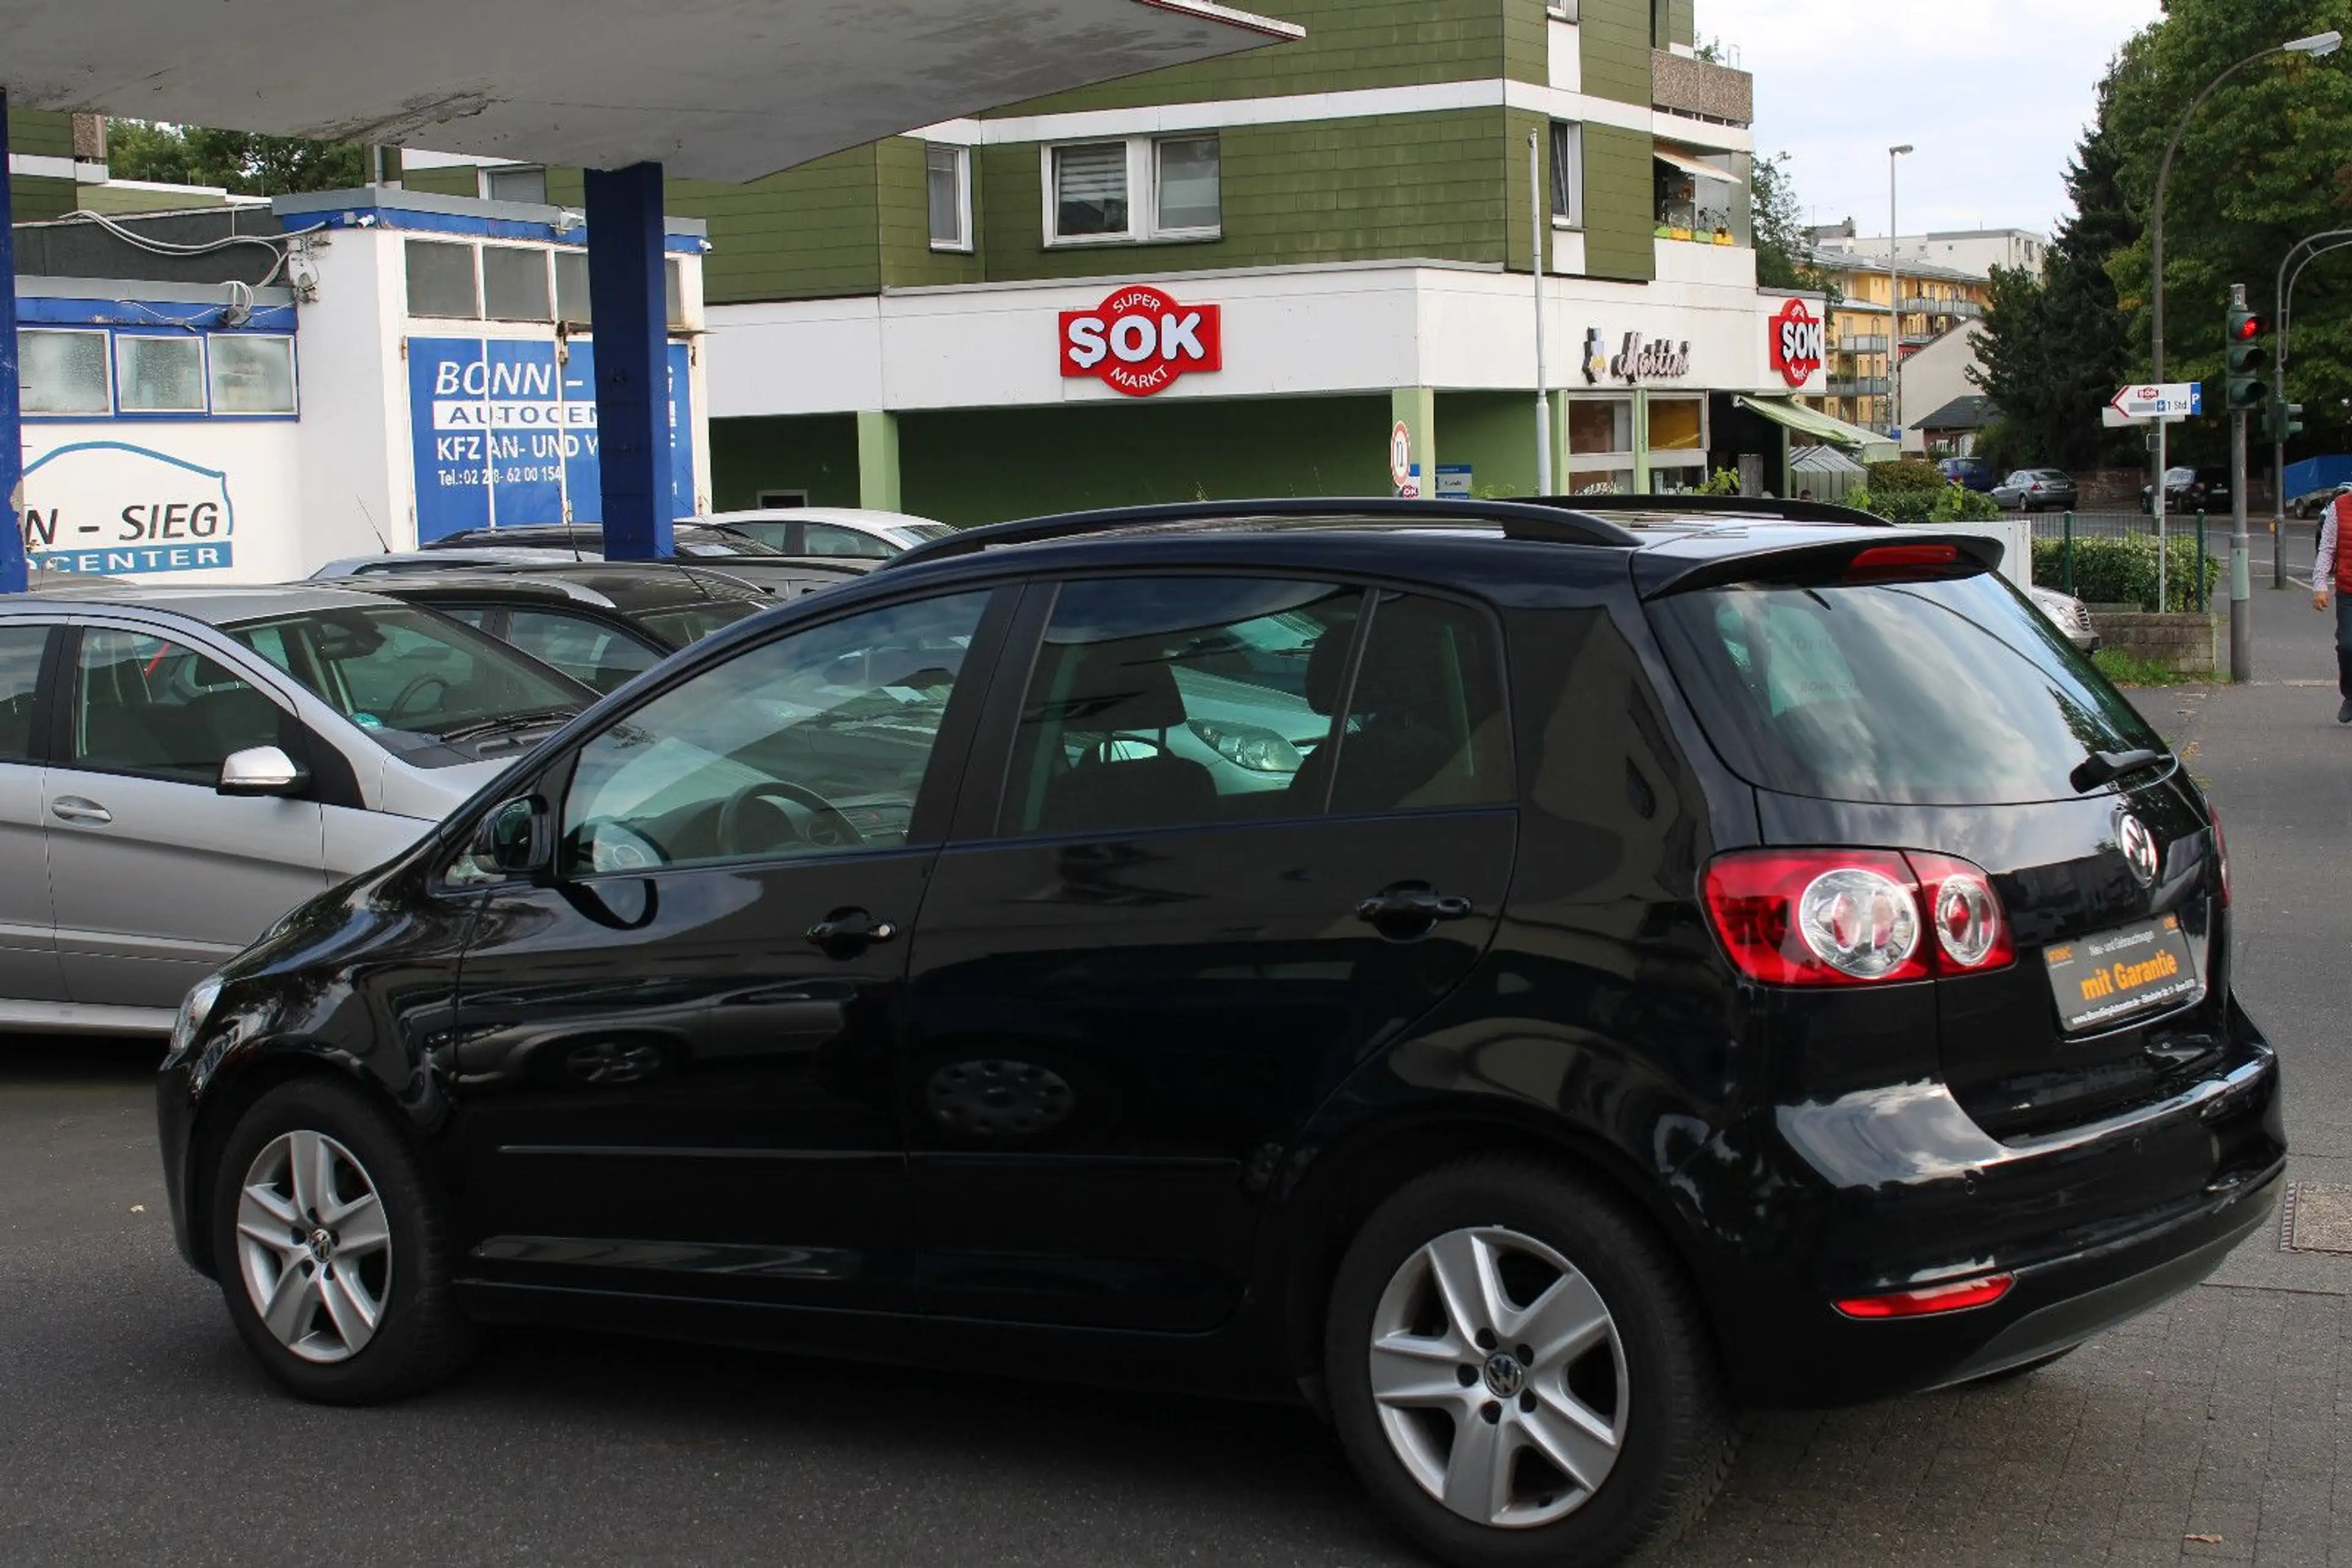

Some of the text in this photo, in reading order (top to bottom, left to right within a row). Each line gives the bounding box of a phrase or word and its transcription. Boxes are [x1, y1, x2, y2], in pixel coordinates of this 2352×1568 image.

[1112, 293, 1161, 314] SUPER
[434, 360, 551, 395] BONN
[1110, 364, 1169, 389] MARKT
[437, 435, 481, 461] KFZ
[532, 434, 579, 458] UND
[524, 466, 538, 482] 00
[119, 502, 219, 540] SIEG
[2080, 968, 2114, 1001] mit
[2114, 949, 2178, 990] Garantie
